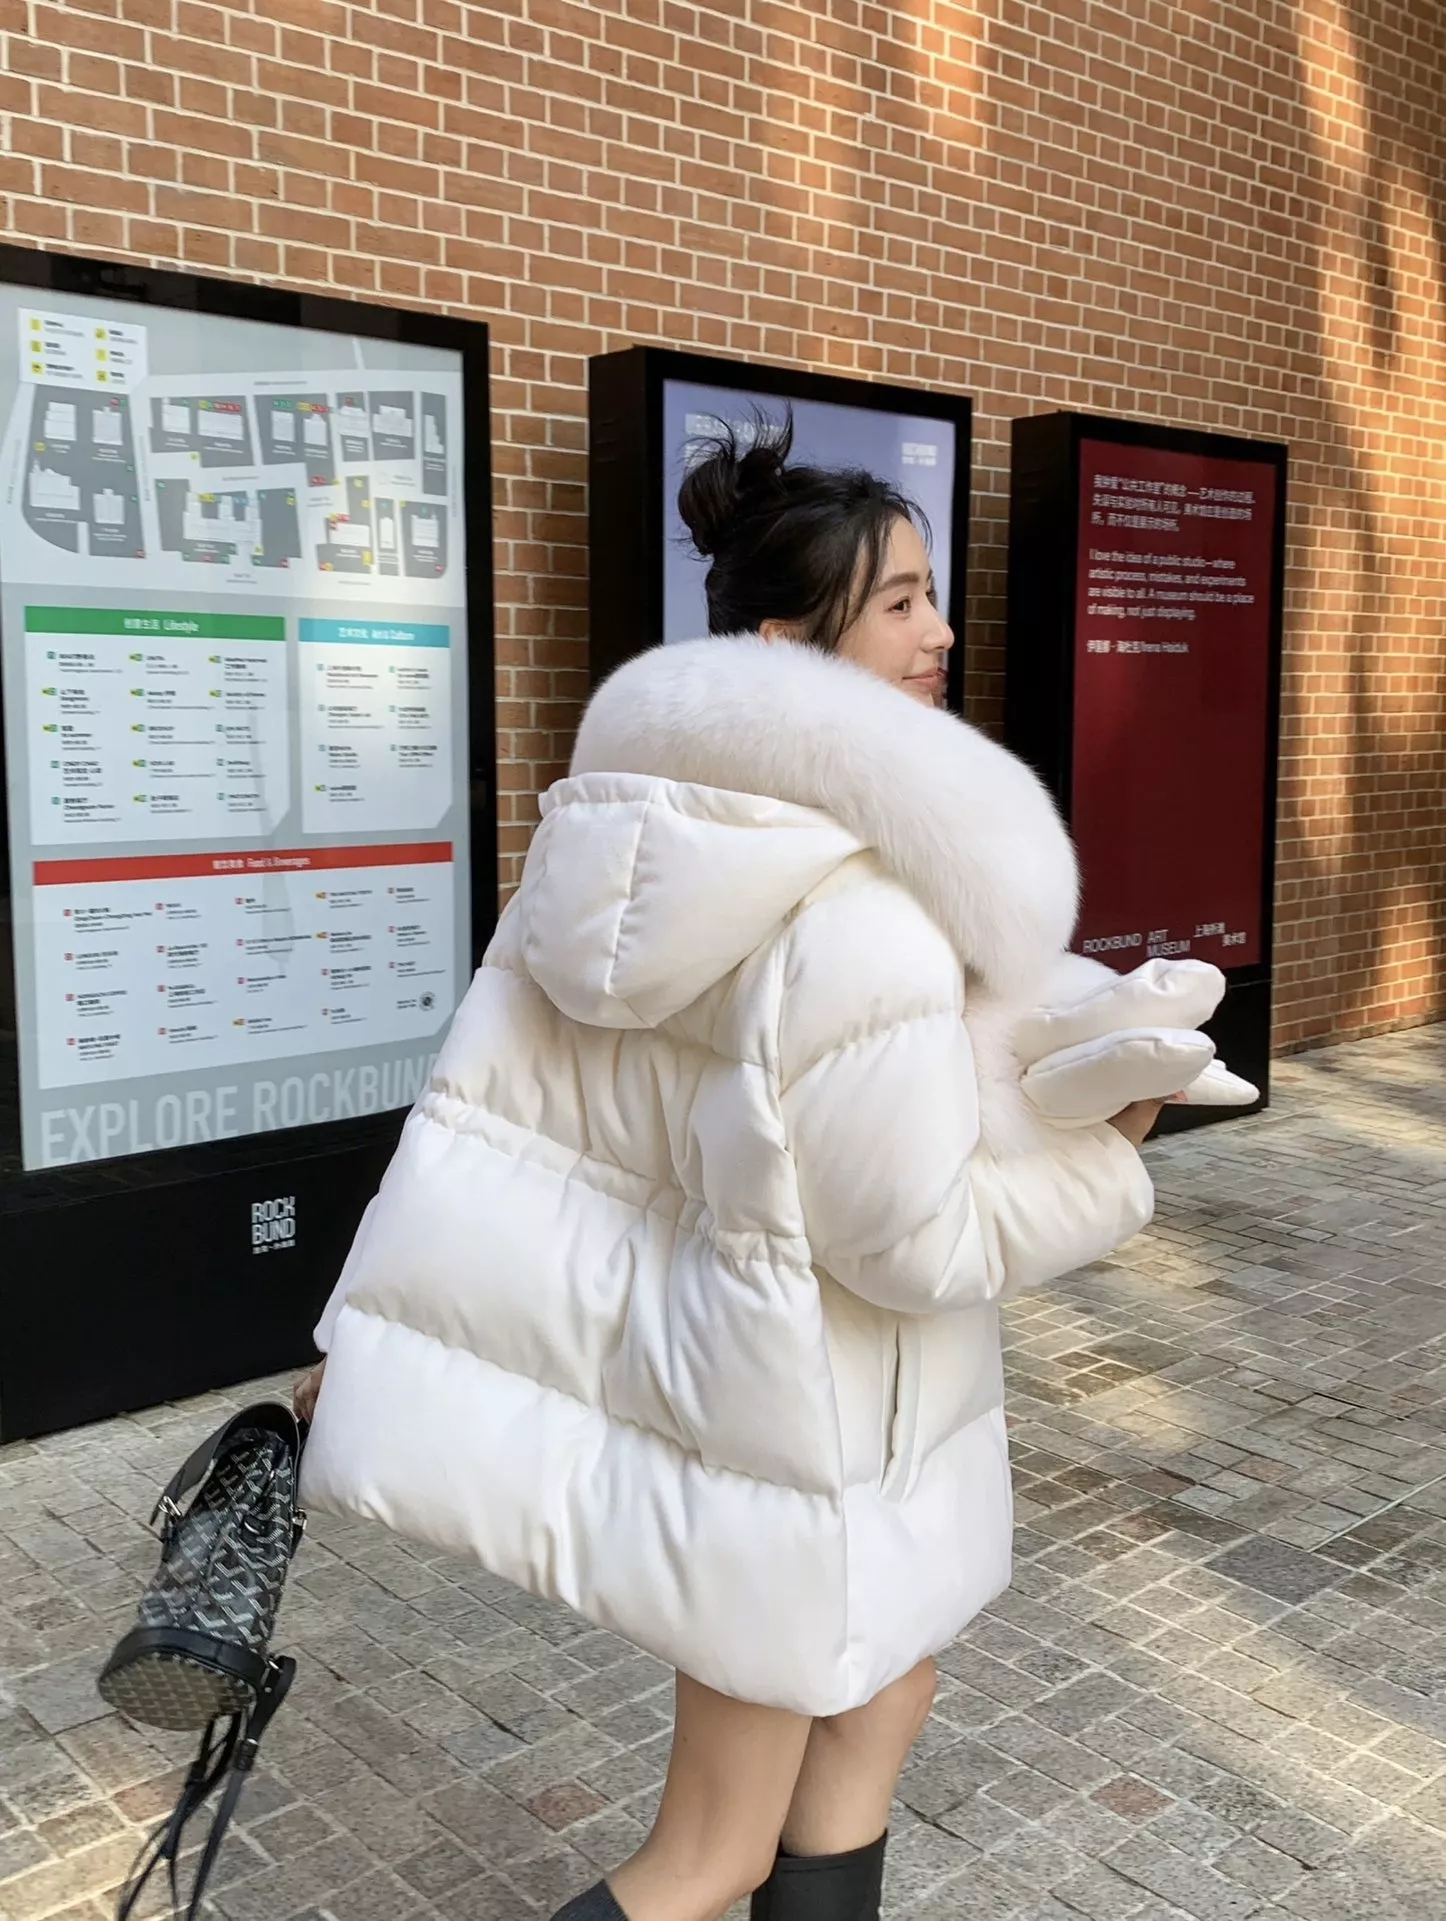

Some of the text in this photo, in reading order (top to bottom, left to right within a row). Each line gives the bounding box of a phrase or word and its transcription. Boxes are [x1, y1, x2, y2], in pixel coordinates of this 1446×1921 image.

[1083, 929, 1169, 953] ROCKBUND ART
[1147, 940, 1190, 957] MUSEUM
[42, 1086, 239, 1165] EXPLORE
[251, 1195, 296, 1223] ROCK
[251, 1218, 296, 1245] BUND
